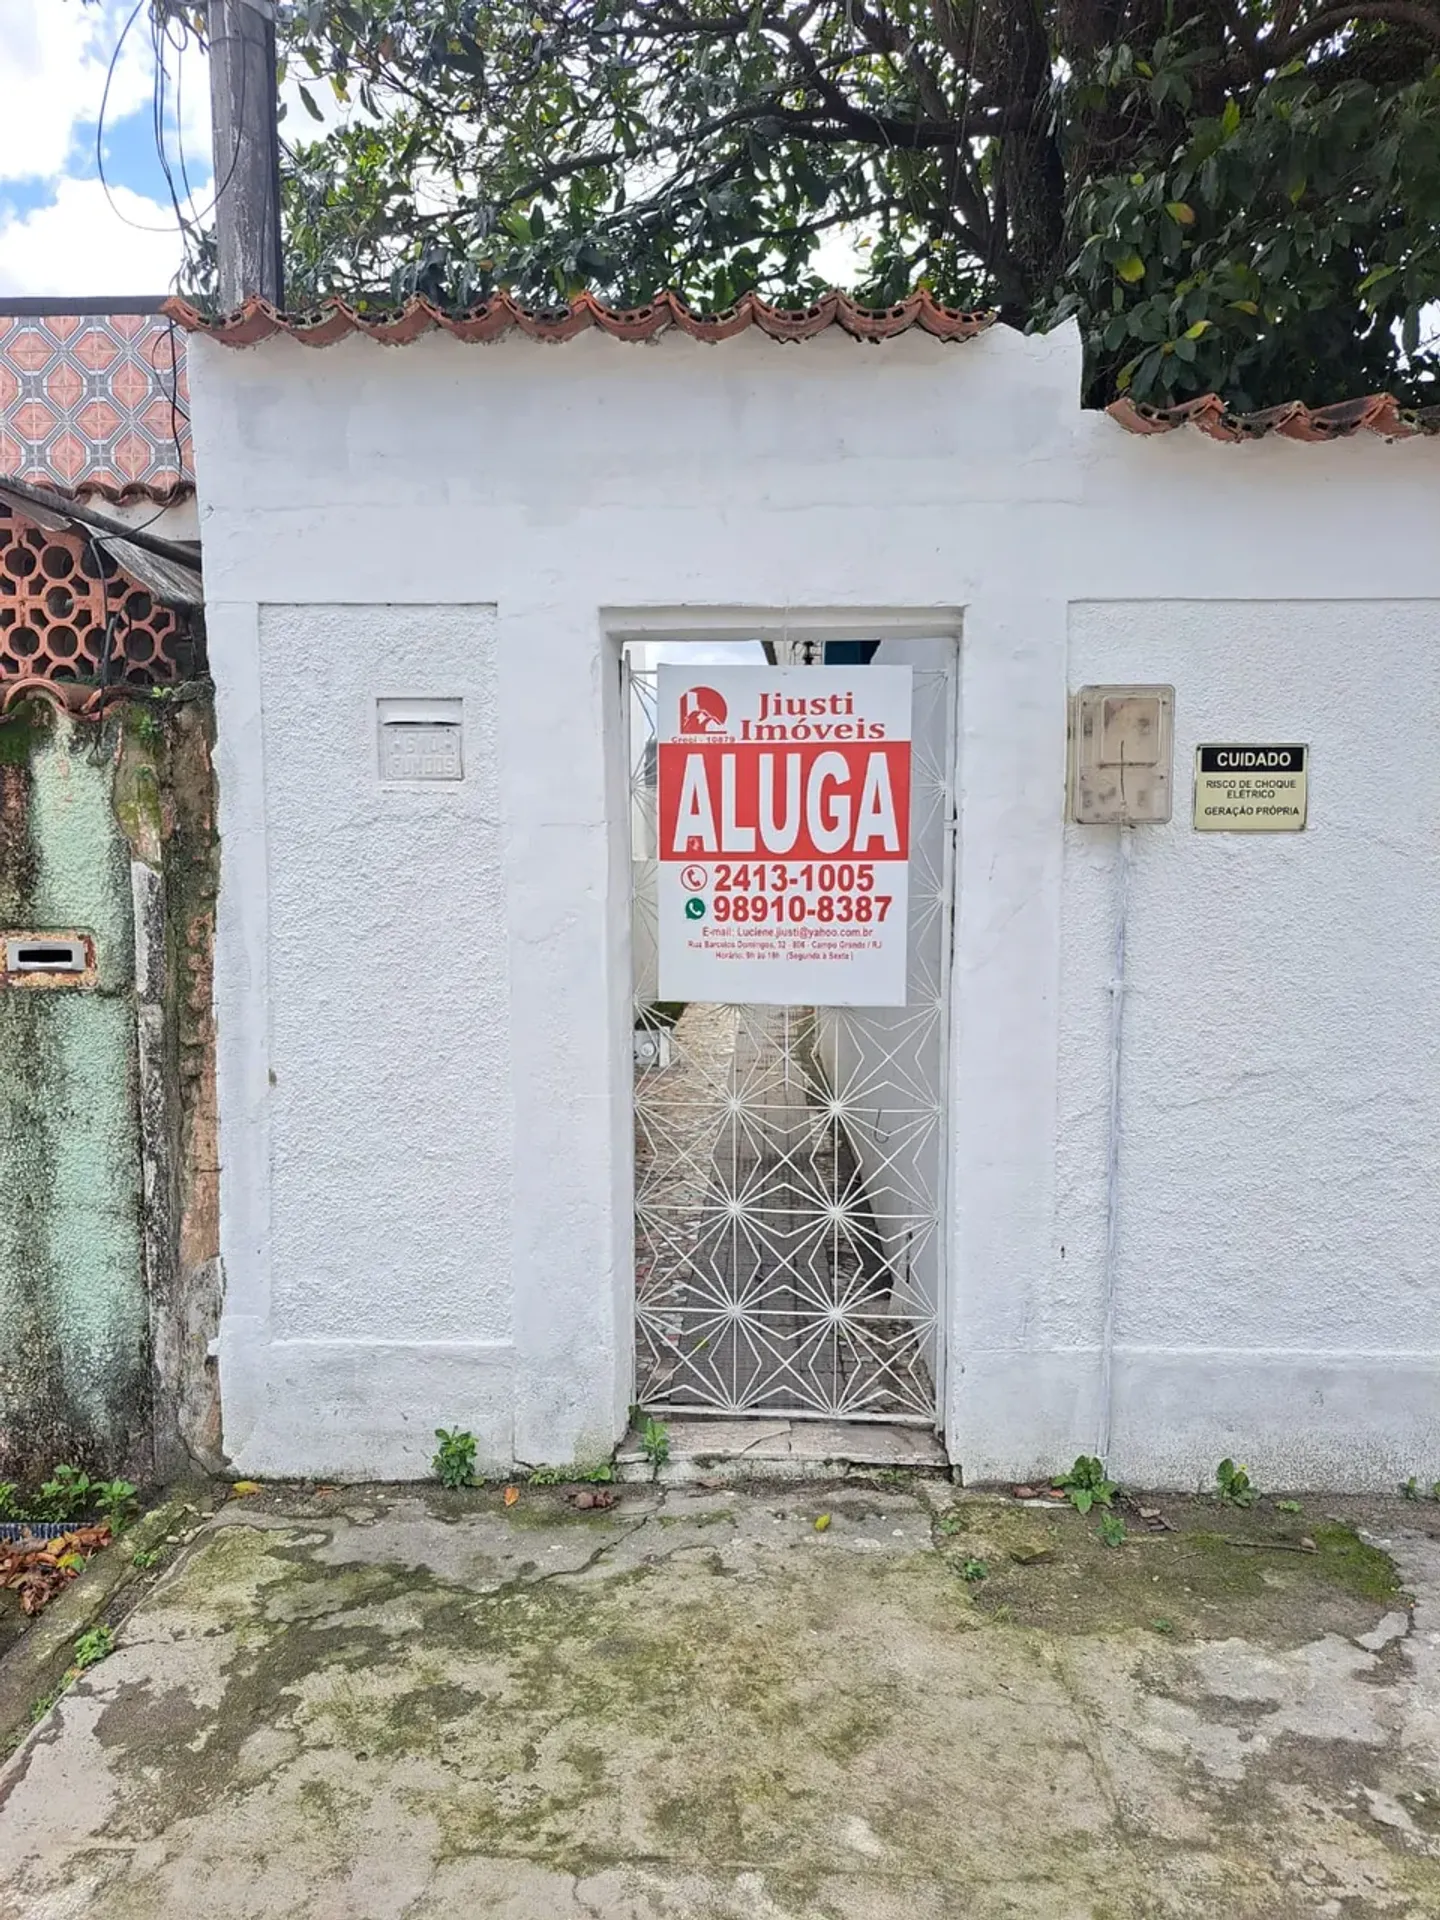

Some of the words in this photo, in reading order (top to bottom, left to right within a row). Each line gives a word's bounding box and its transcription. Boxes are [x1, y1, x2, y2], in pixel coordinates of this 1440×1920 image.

[759, 692, 854, 721] Jiusti
[740, 718, 886, 741] Imóveis
[1217, 751, 1291, 767] CUIDADO
[1206, 780, 1237, 789] RISCO
[1239, 780, 1251, 789] DE
[1254, 780, 1297, 789] CHOQUE
[672, 751, 901, 854] ALUGA
[1204, 805, 1254, 818] GERAÇÃO
[1256, 805, 1300, 816] PRÓPRIA
[714, 864, 875, 892] 2413-1005
[713, 895, 893, 922] 98910-8387
[688, 940, 702, 948] Rua
[811, 941, 838, 950] Campo
[839, 940, 865, 949] Grande
